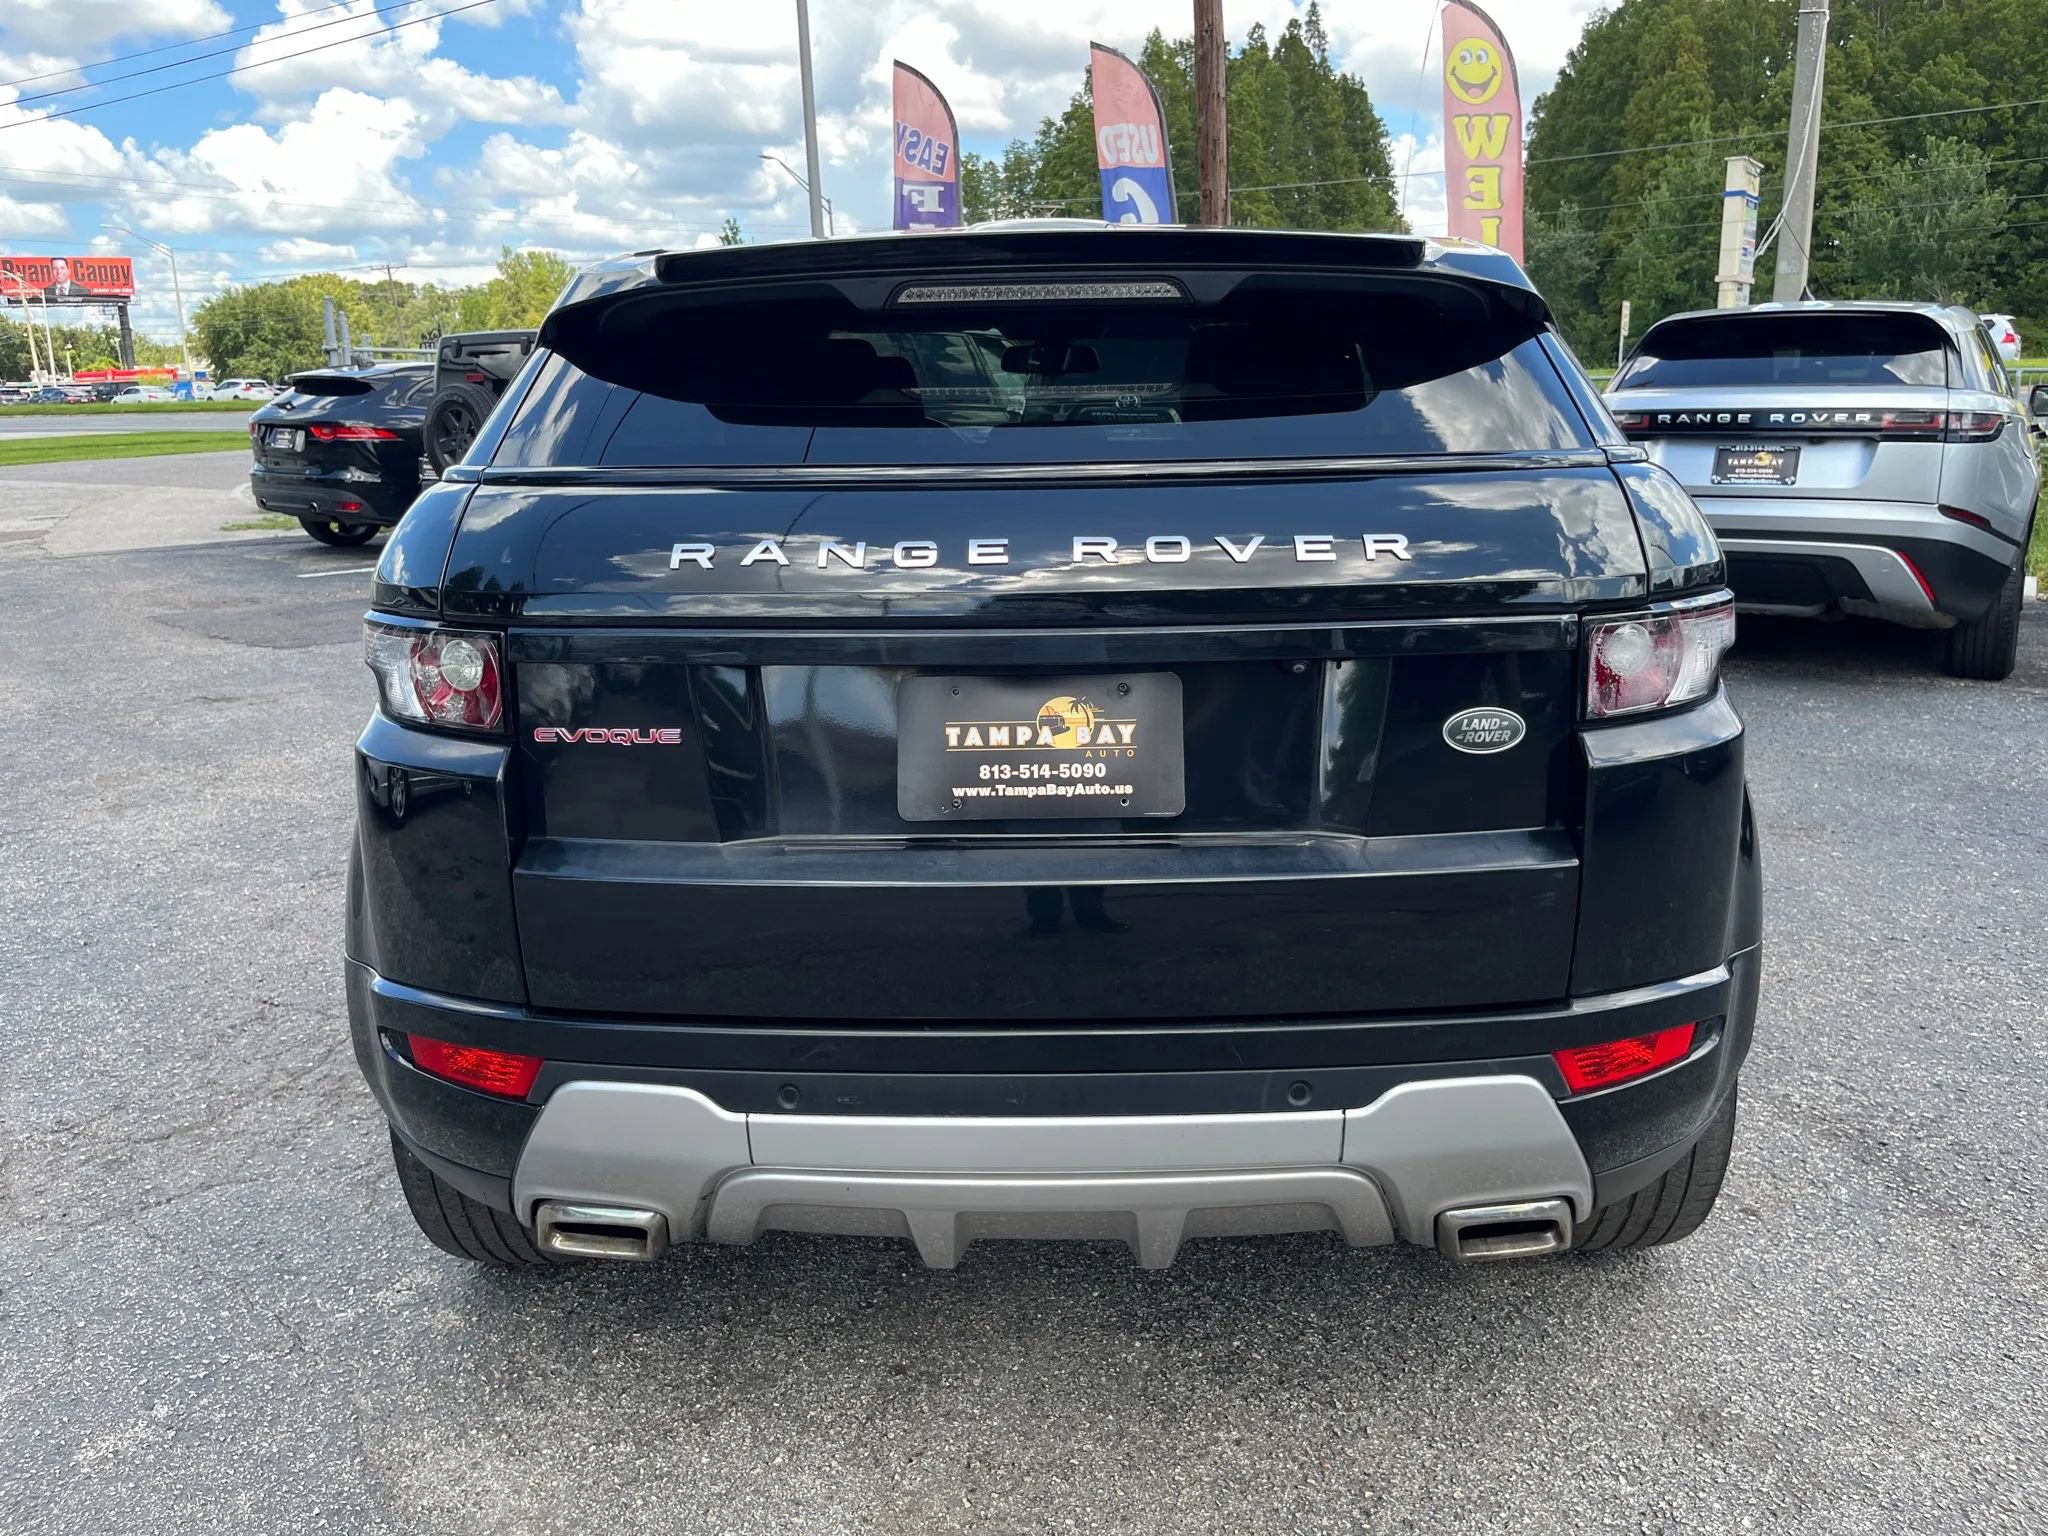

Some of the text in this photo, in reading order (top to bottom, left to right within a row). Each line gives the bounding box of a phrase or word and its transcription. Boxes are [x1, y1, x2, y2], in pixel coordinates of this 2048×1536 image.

[1, 259, 130, 286] Ryan Cappy
[1657, 413, 1871, 424] RANGE ROVER
[669, 533, 1412, 569] RANGE ROVER
[1461, 718, 1500, 731] LAND
[534, 727, 682, 746] EVOQUE
[945, 723, 1136, 747] TAMPA BAY
[1463, 730, 1511, 743] ROVER
[1085, 749, 1135, 758] AUTO
[979, 763, 1106, 780] 813-514-5090
[952, 783, 1133, 798] www.TampaBayAuto.us
